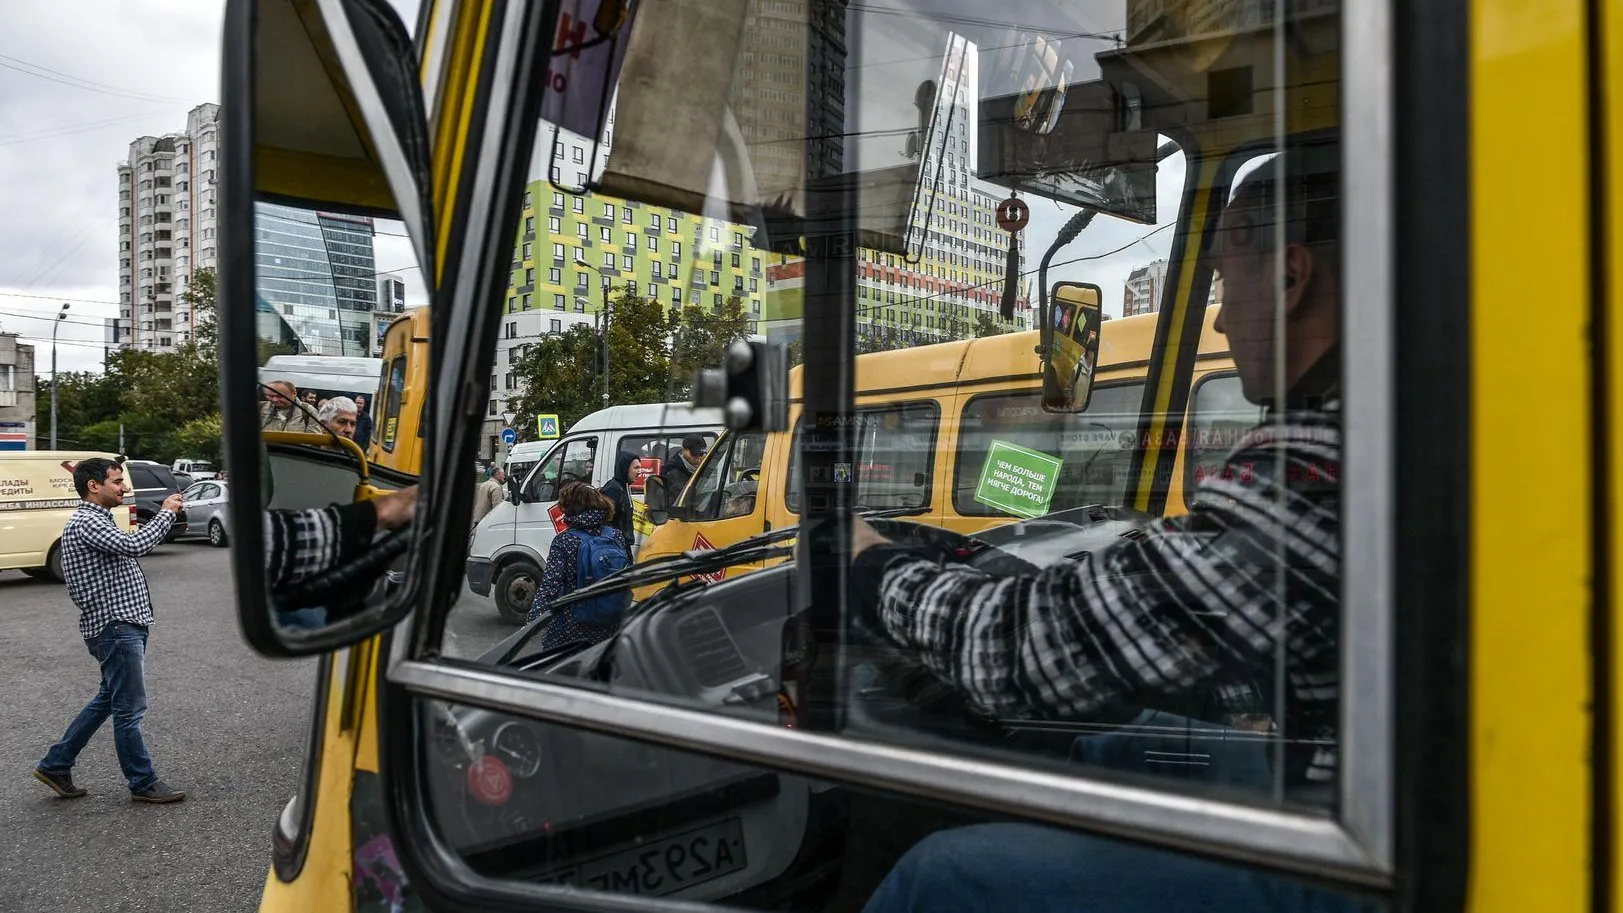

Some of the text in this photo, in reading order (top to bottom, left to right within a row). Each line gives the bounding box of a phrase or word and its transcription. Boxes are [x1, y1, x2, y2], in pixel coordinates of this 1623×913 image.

[993, 469, 1043, 492] НАРОДА, ТЕМ
[997, 460, 1047, 483] ЧЕМ БОЛЬШЕ
[986, 477, 1011, 491] МЯГЧЕ
[25, 500, 81, 509] ИНКАССАЦ
